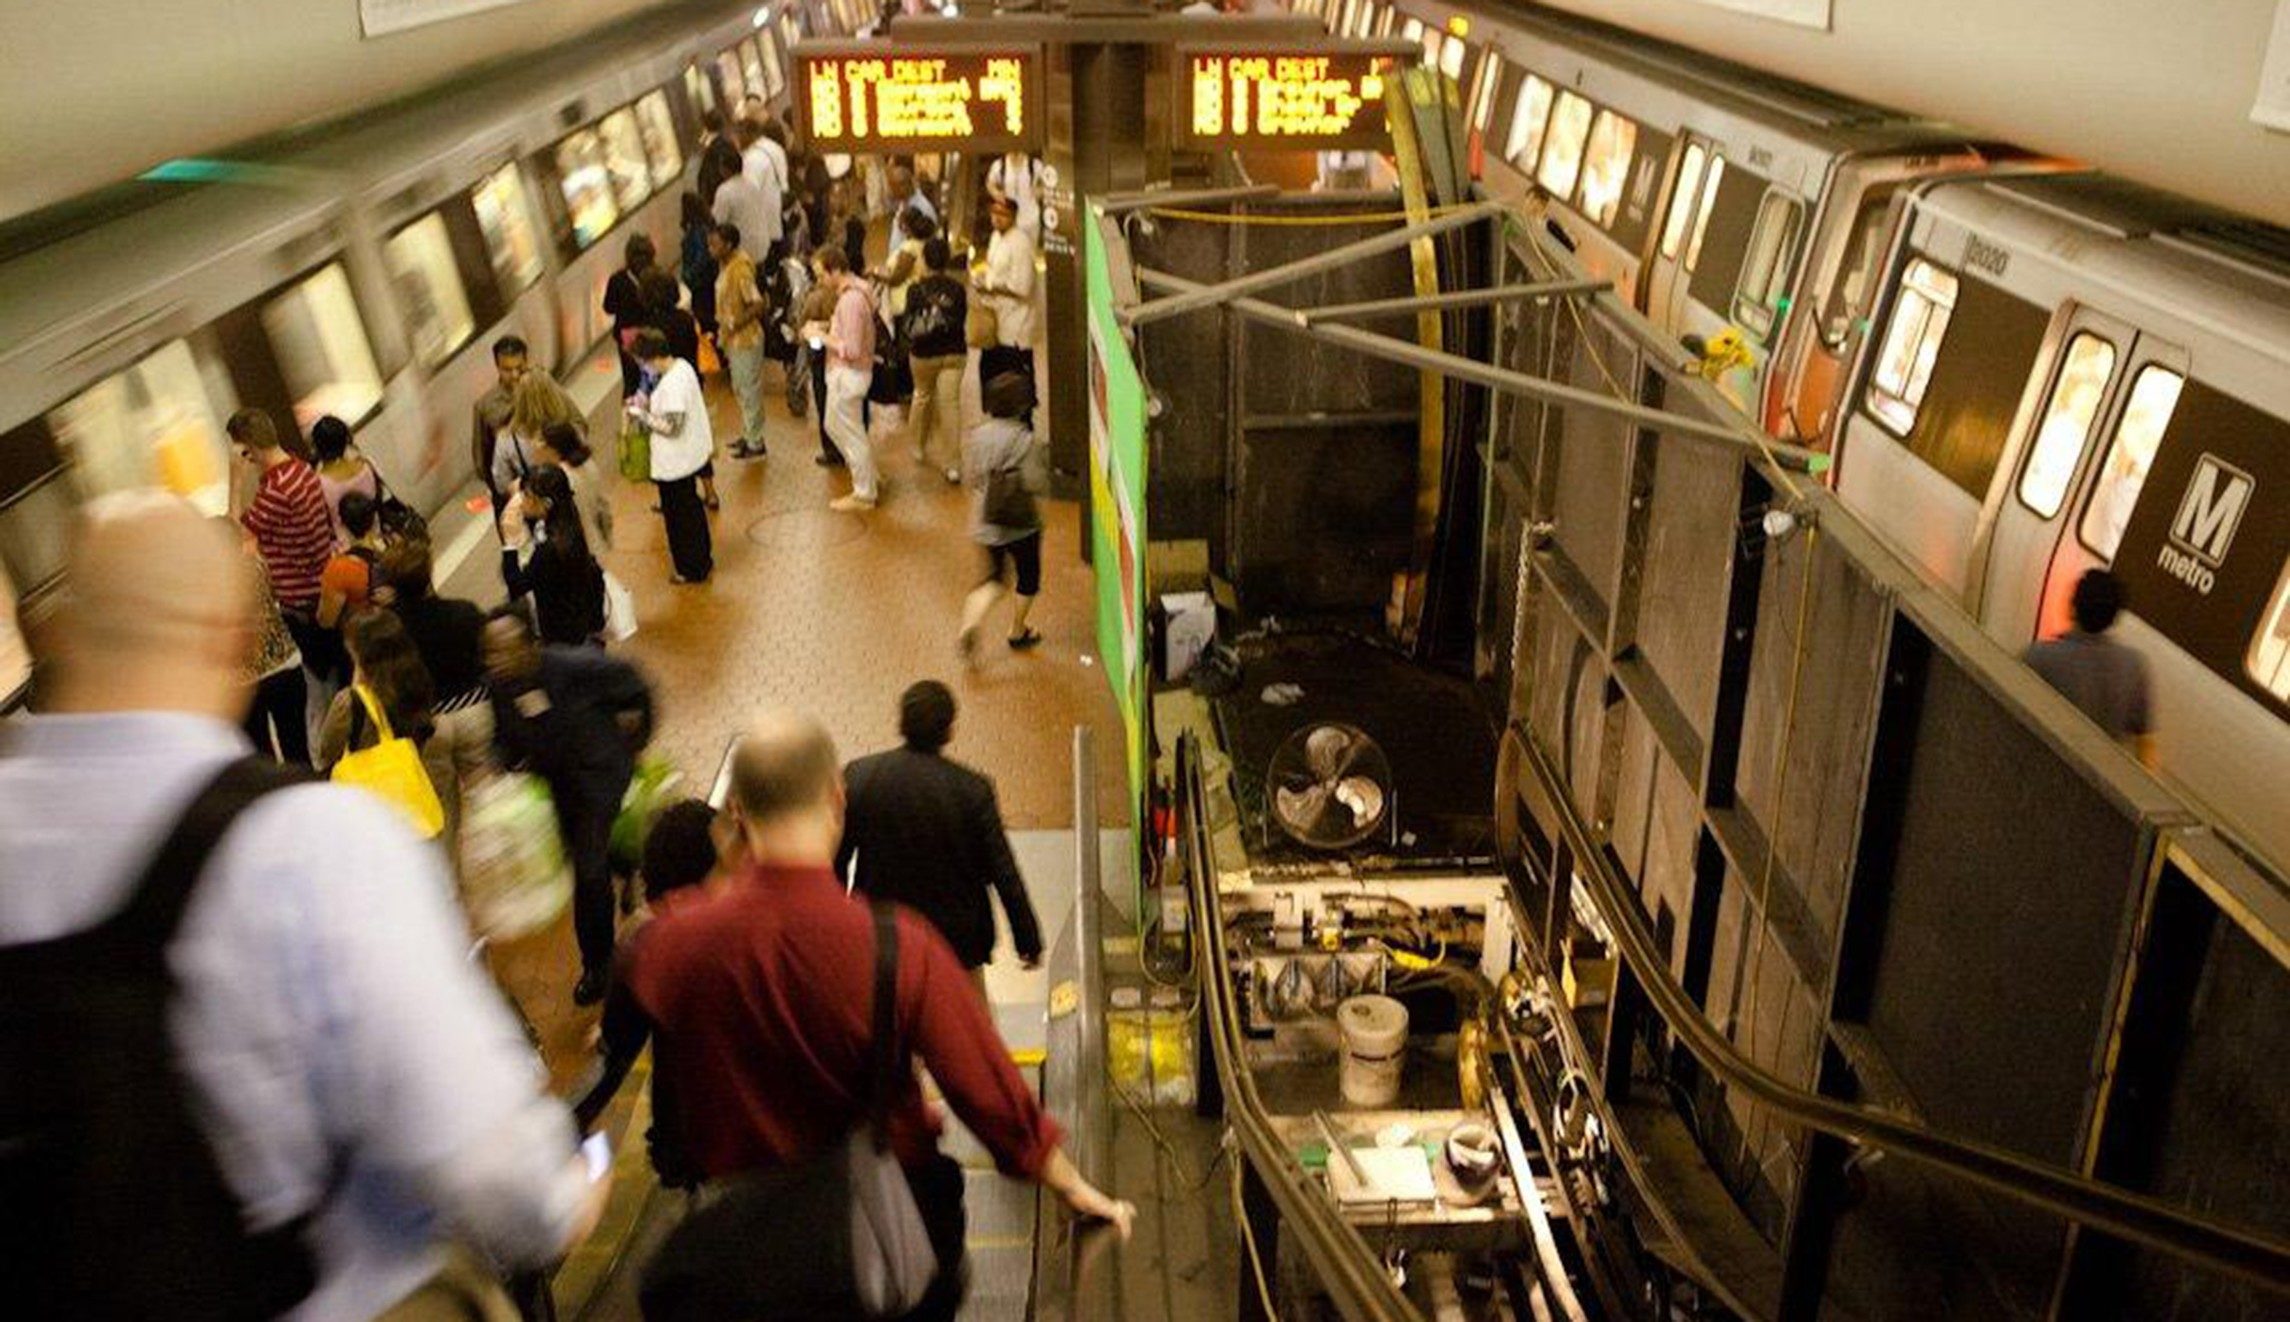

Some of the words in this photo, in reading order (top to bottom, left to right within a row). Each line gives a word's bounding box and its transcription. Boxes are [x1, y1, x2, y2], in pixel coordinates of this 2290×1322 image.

[845, 60, 886, 81] CAR
[892, 60, 946, 81] DEST
[1229, 58, 1270, 78] CAR
[1276, 58, 1329, 78] DEST
[2174, 459, 2250, 560] M
[2157, 543, 2215, 596] metro
